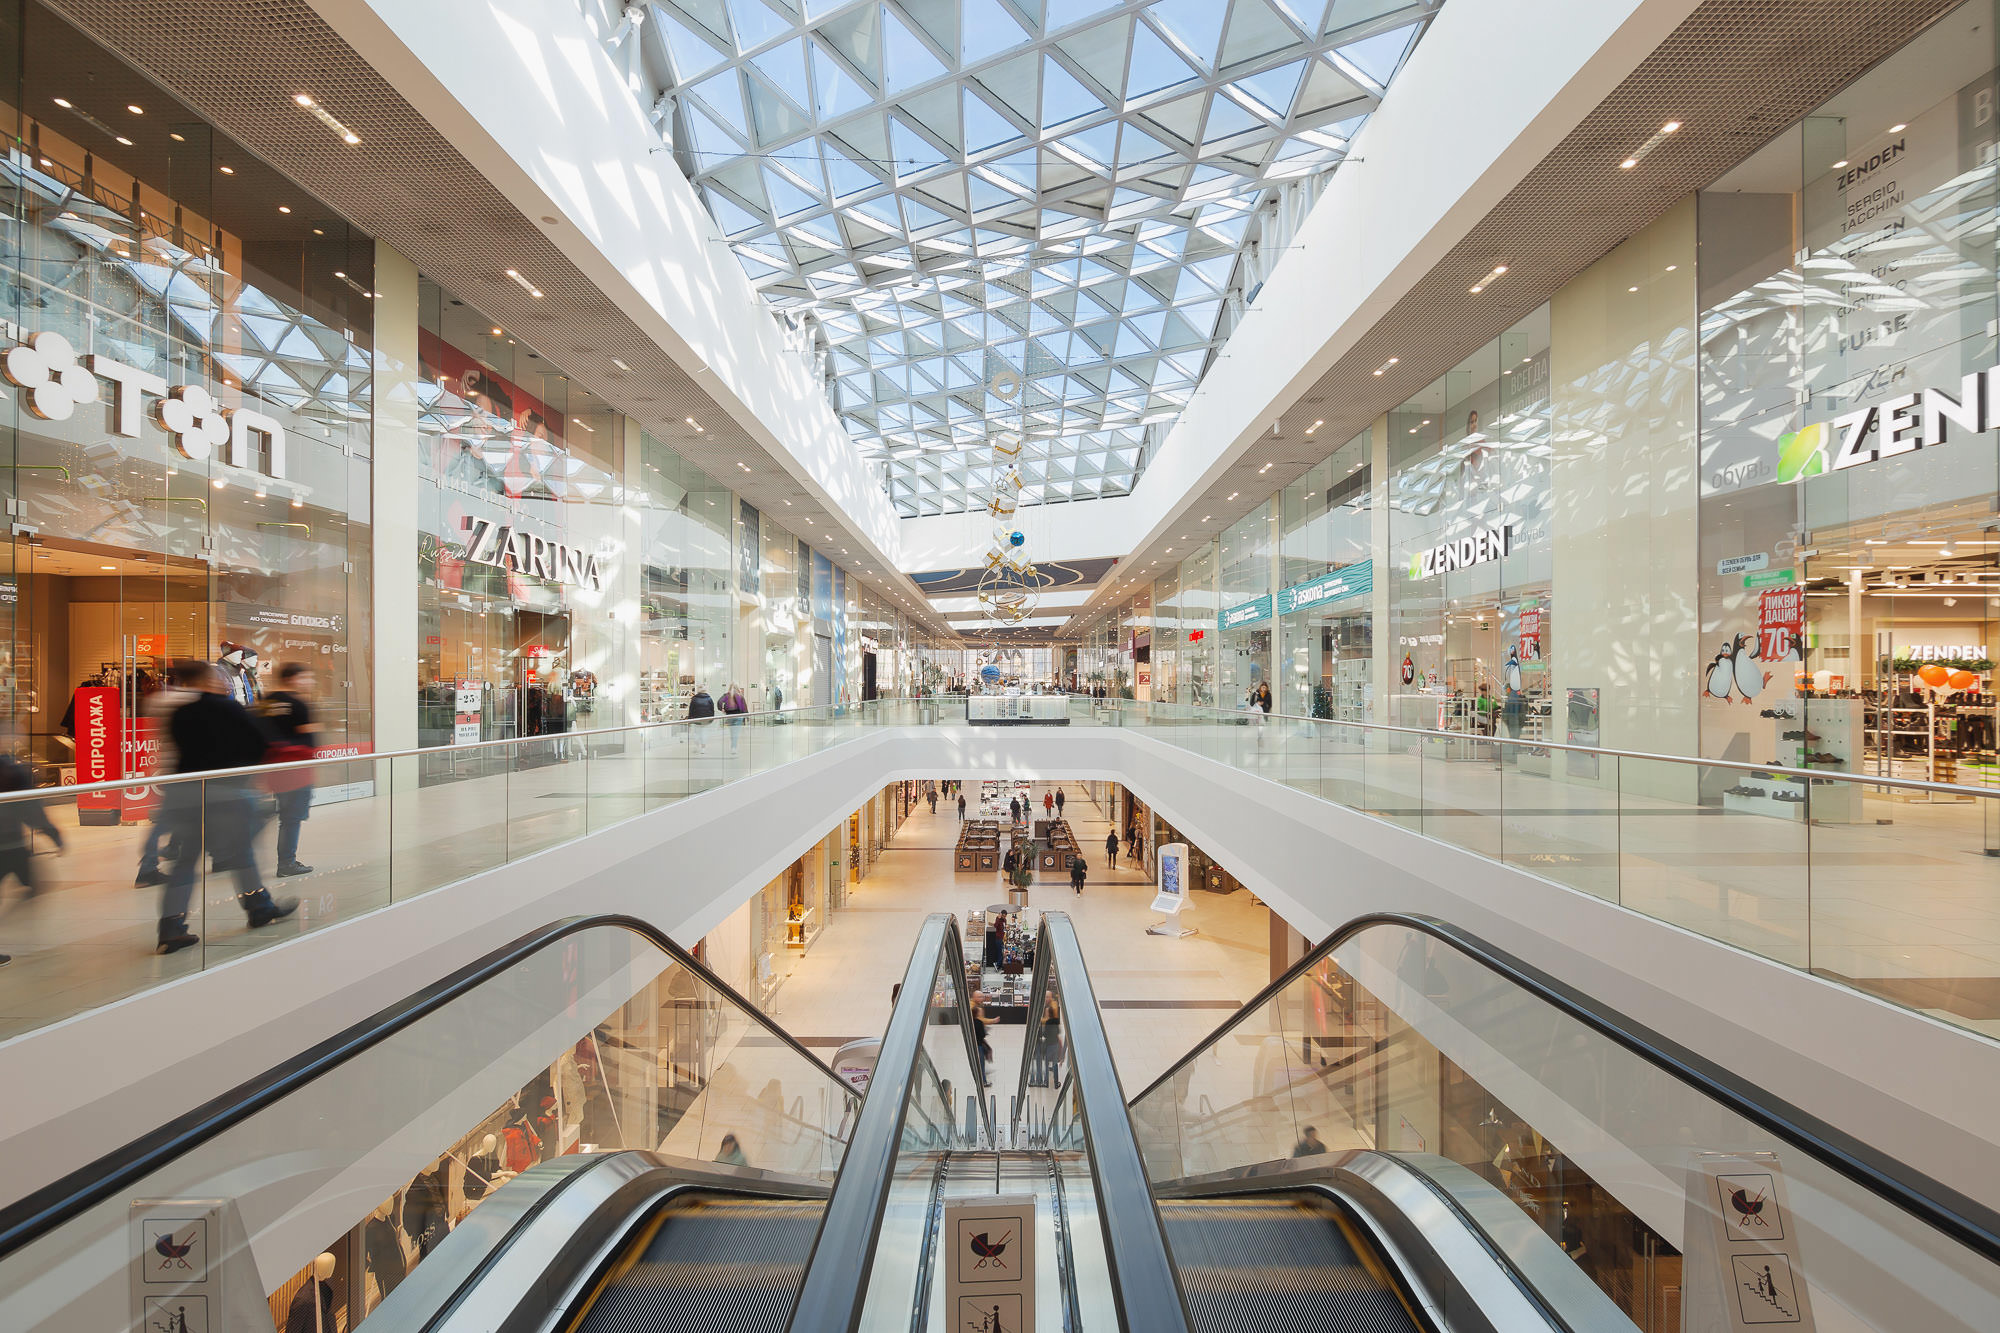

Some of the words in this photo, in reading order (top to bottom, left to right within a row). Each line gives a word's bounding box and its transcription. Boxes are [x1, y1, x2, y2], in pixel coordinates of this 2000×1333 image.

[1837, 138, 1905, 191] ZENDEN
[1840, 190, 1905, 233] TACCHINI
[1847, 180, 1897, 217] SERGIO
[1832, 365, 2000, 471] ZEN
[1711, 461, 1771, 490] обувь
[1514, 527, 1545, 546] обувь
[462, 515, 601, 592] ZARINA
[1421, 525, 1509, 578] ZENDEN
[1297, 584, 1323, 605] askona
[1764, 593, 1798, 611] ЛИКВИ
[1764, 608, 1798, 625] ДАЦИЯ
[137, 644, 151, 652] 50
[1764, 626, 1790, 658] 70
[1910, 645, 1987, 660] ZENDEN
[312, 747, 359, 760] АСПРОДАЖА
[411, 1221, 436, 1249] OSS
